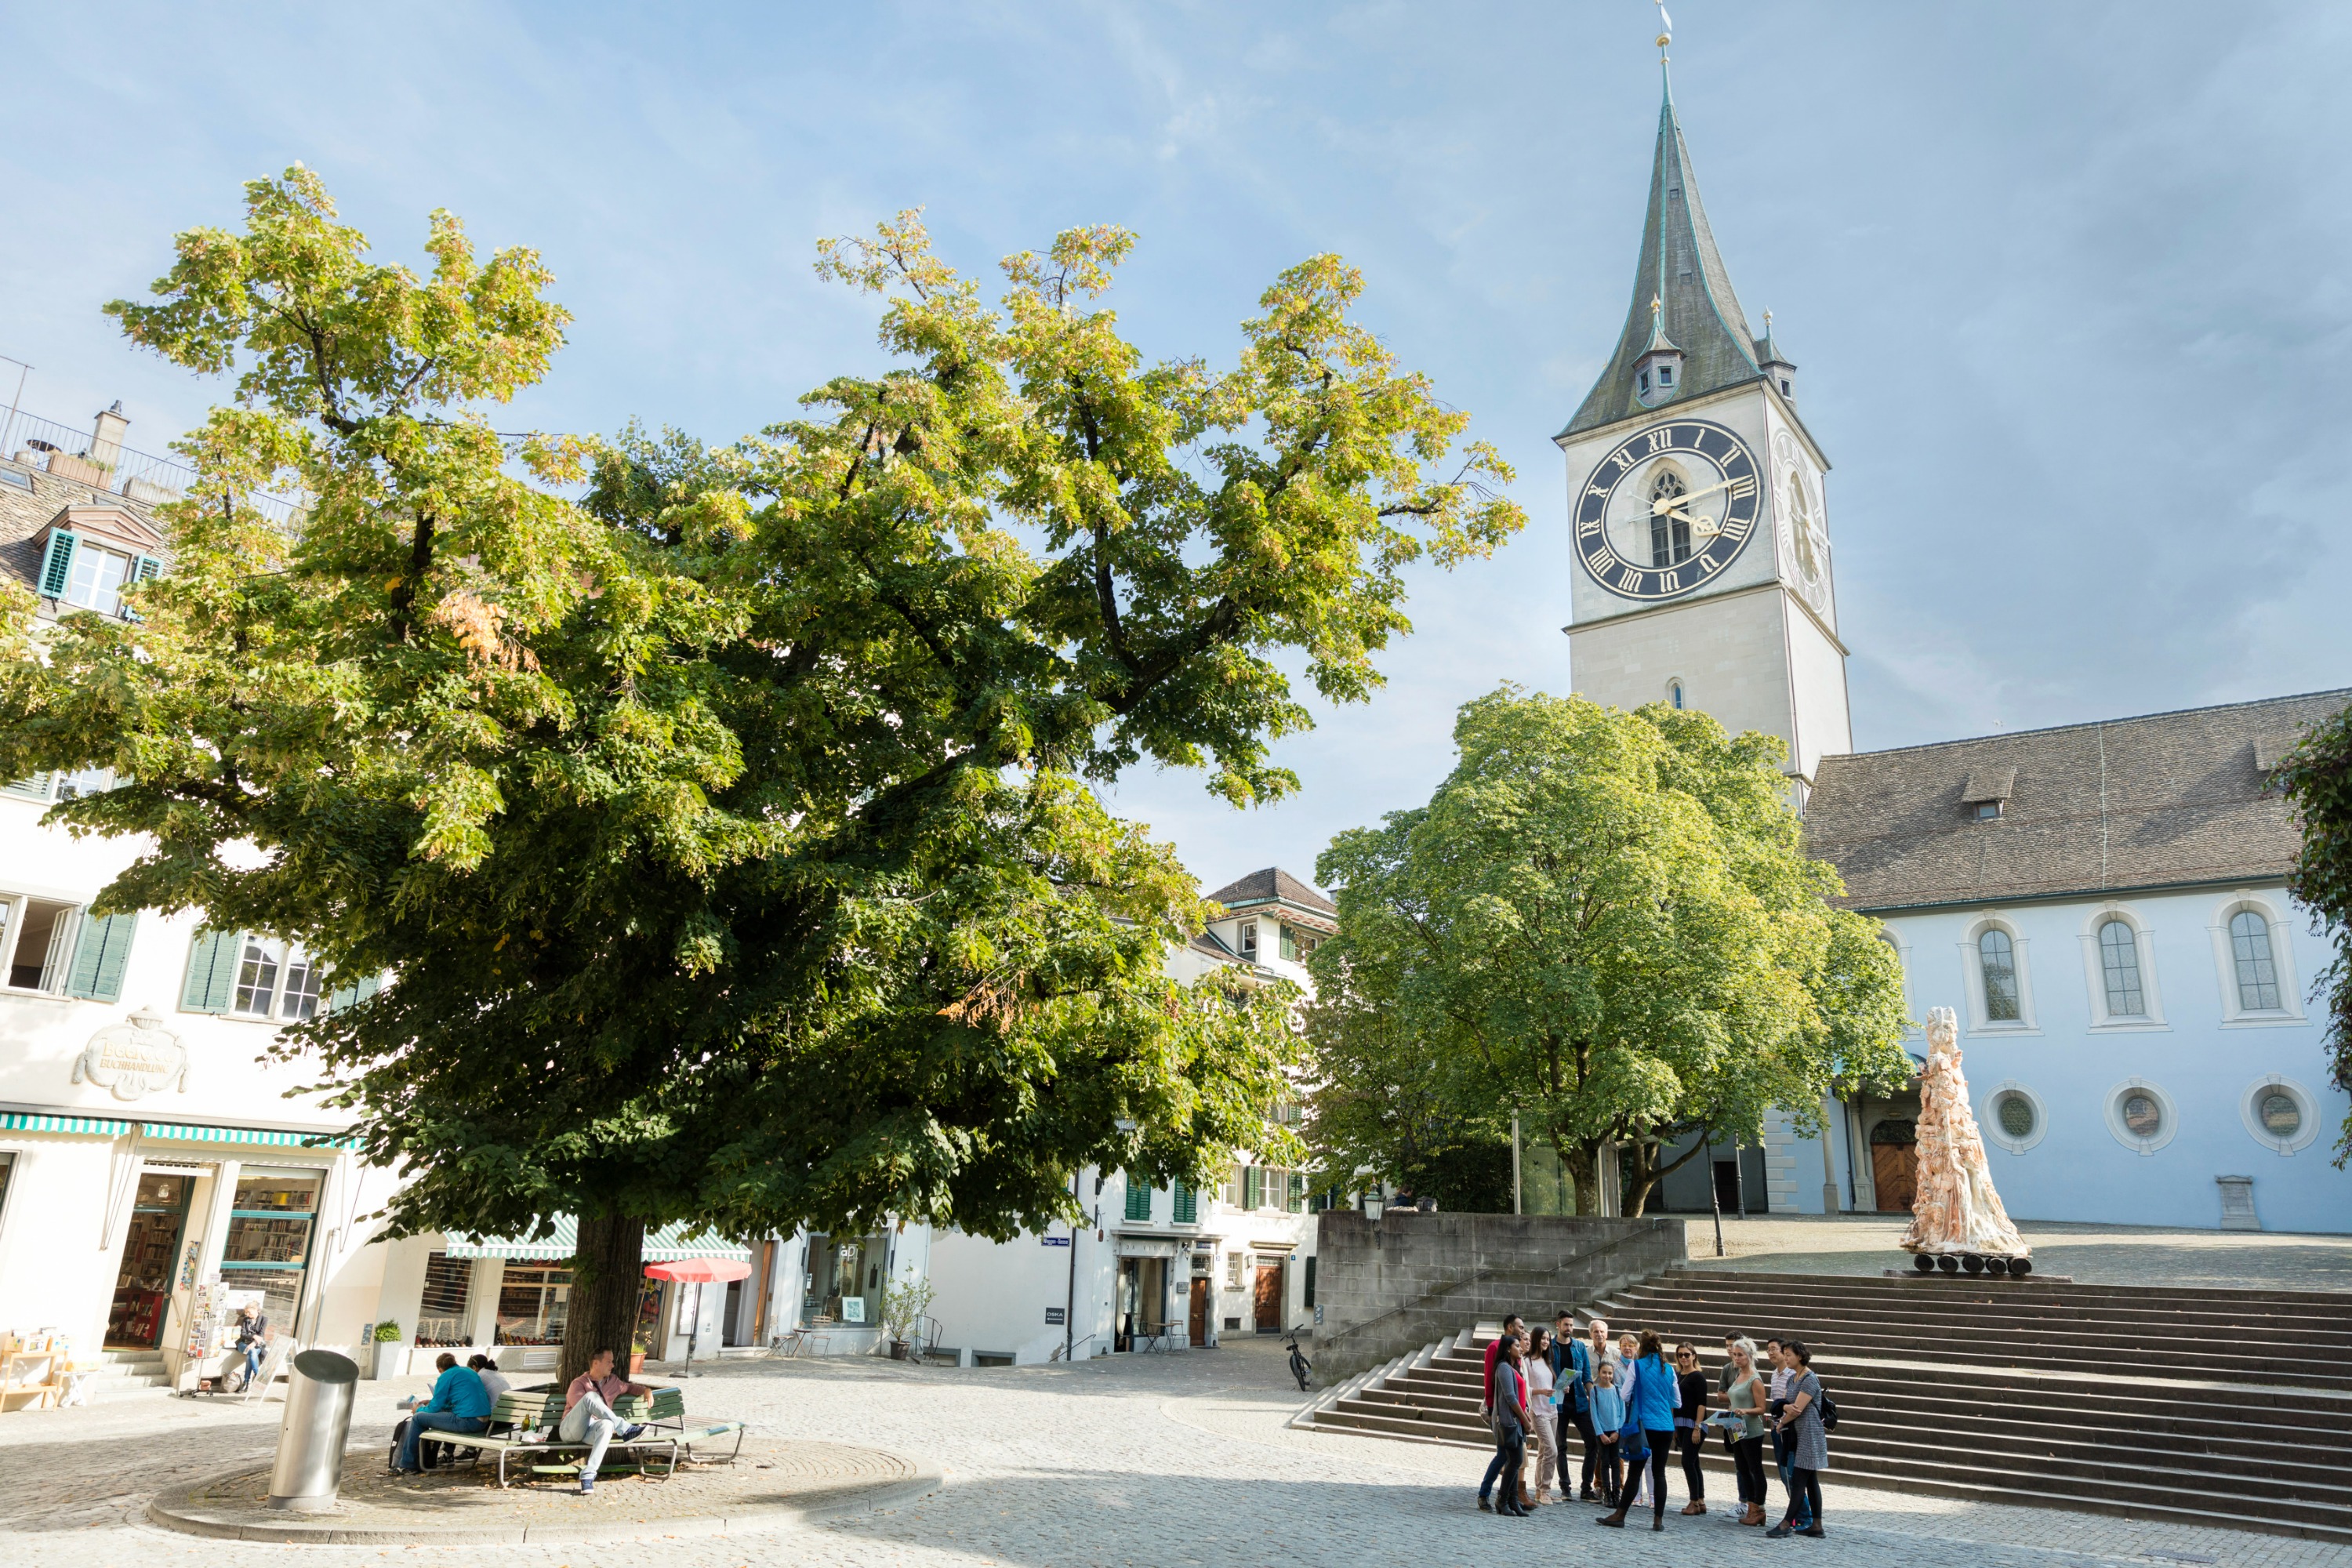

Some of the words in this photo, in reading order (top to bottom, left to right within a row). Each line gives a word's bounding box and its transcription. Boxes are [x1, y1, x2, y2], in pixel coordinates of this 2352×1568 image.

[1647, 427, 1673, 453] XII
[1693, 427, 1706, 448] I
[1611, 448, 1635, 471] XI
[1719, 445, 1741, 467] II
[1587, 484, 1610, 499] X
[1580, 518, 1601, 539] IX
[1699, 554, 1720, 573] V
[1658, 570, 1681, 593] VI
[100, 1058, 169, 1073] BUCHHANDLUNG
